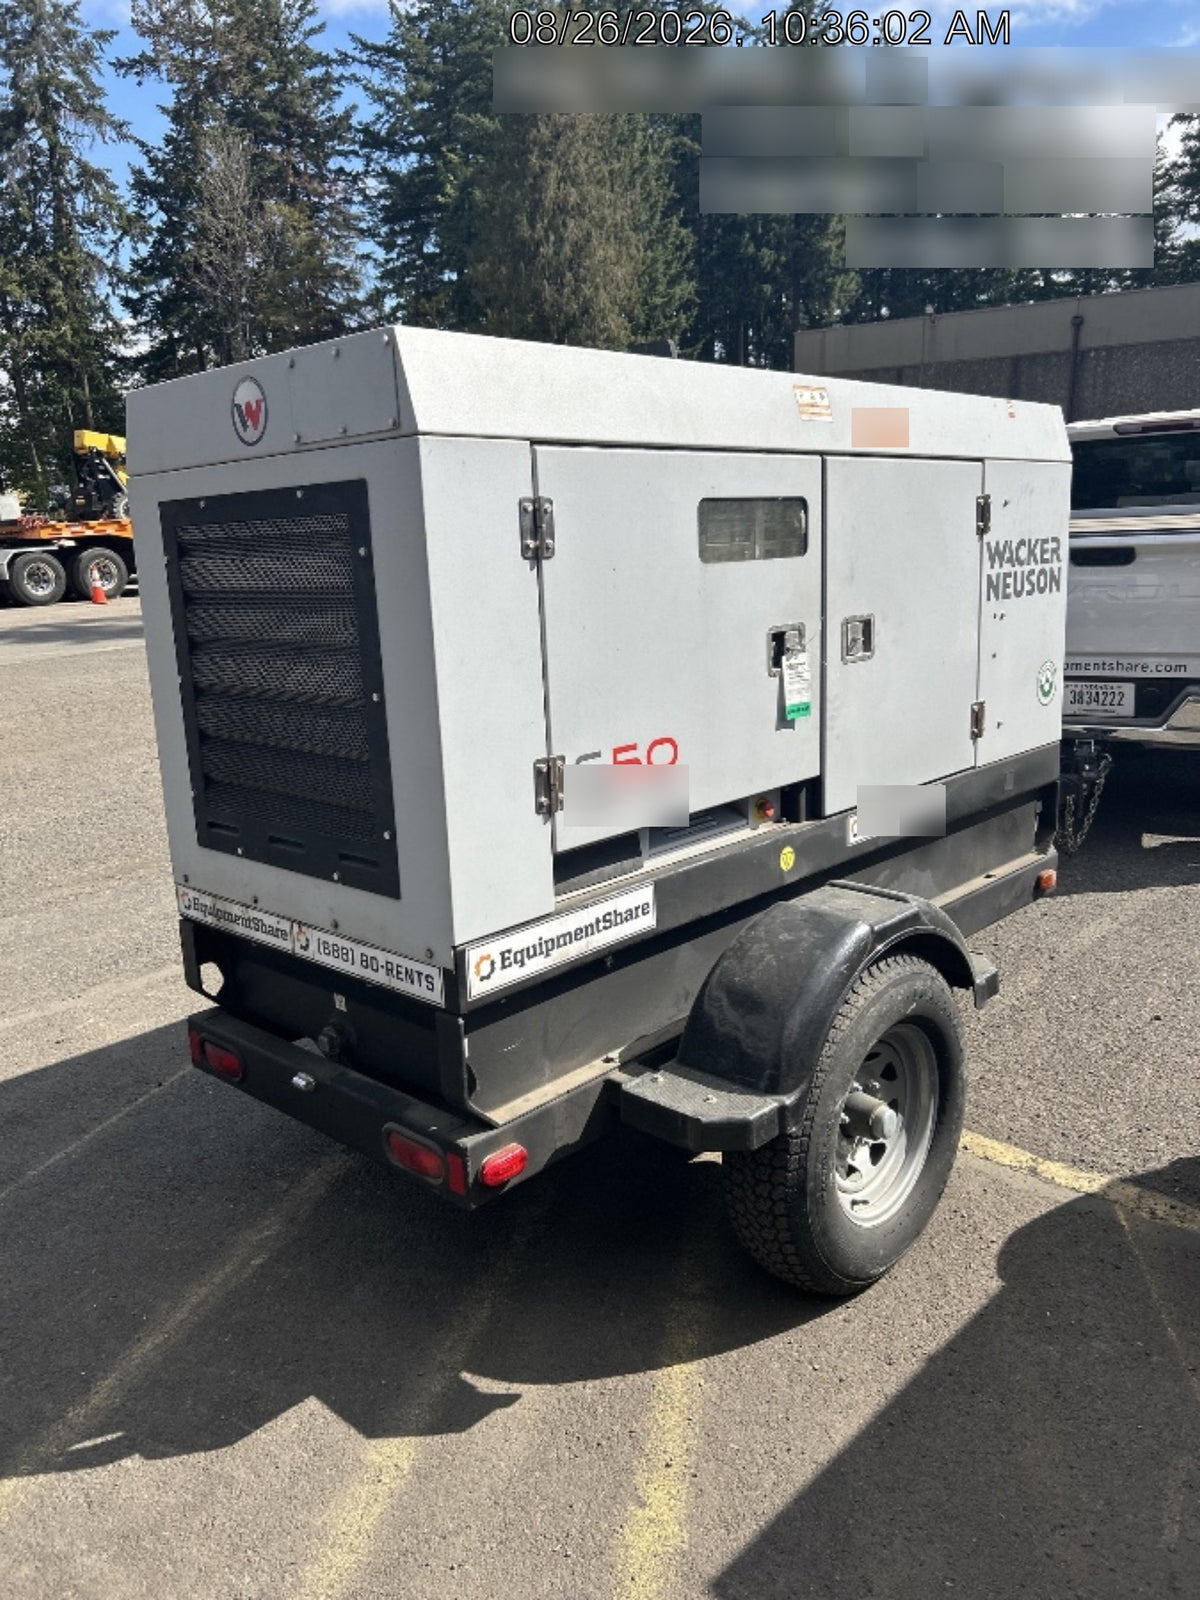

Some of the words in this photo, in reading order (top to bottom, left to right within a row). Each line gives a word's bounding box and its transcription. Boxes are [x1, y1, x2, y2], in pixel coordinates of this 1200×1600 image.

[985, 536, 1063, 570] WACKER
[986, 566, 1062, 602] NEUSON
[193, 897, 289, 941] EquipmentShare
[499, 901, 650, 970] EquipmentShare
[317, 937, 355, 966] (888)
[360, 952, 435, 993] 80-RENTS
